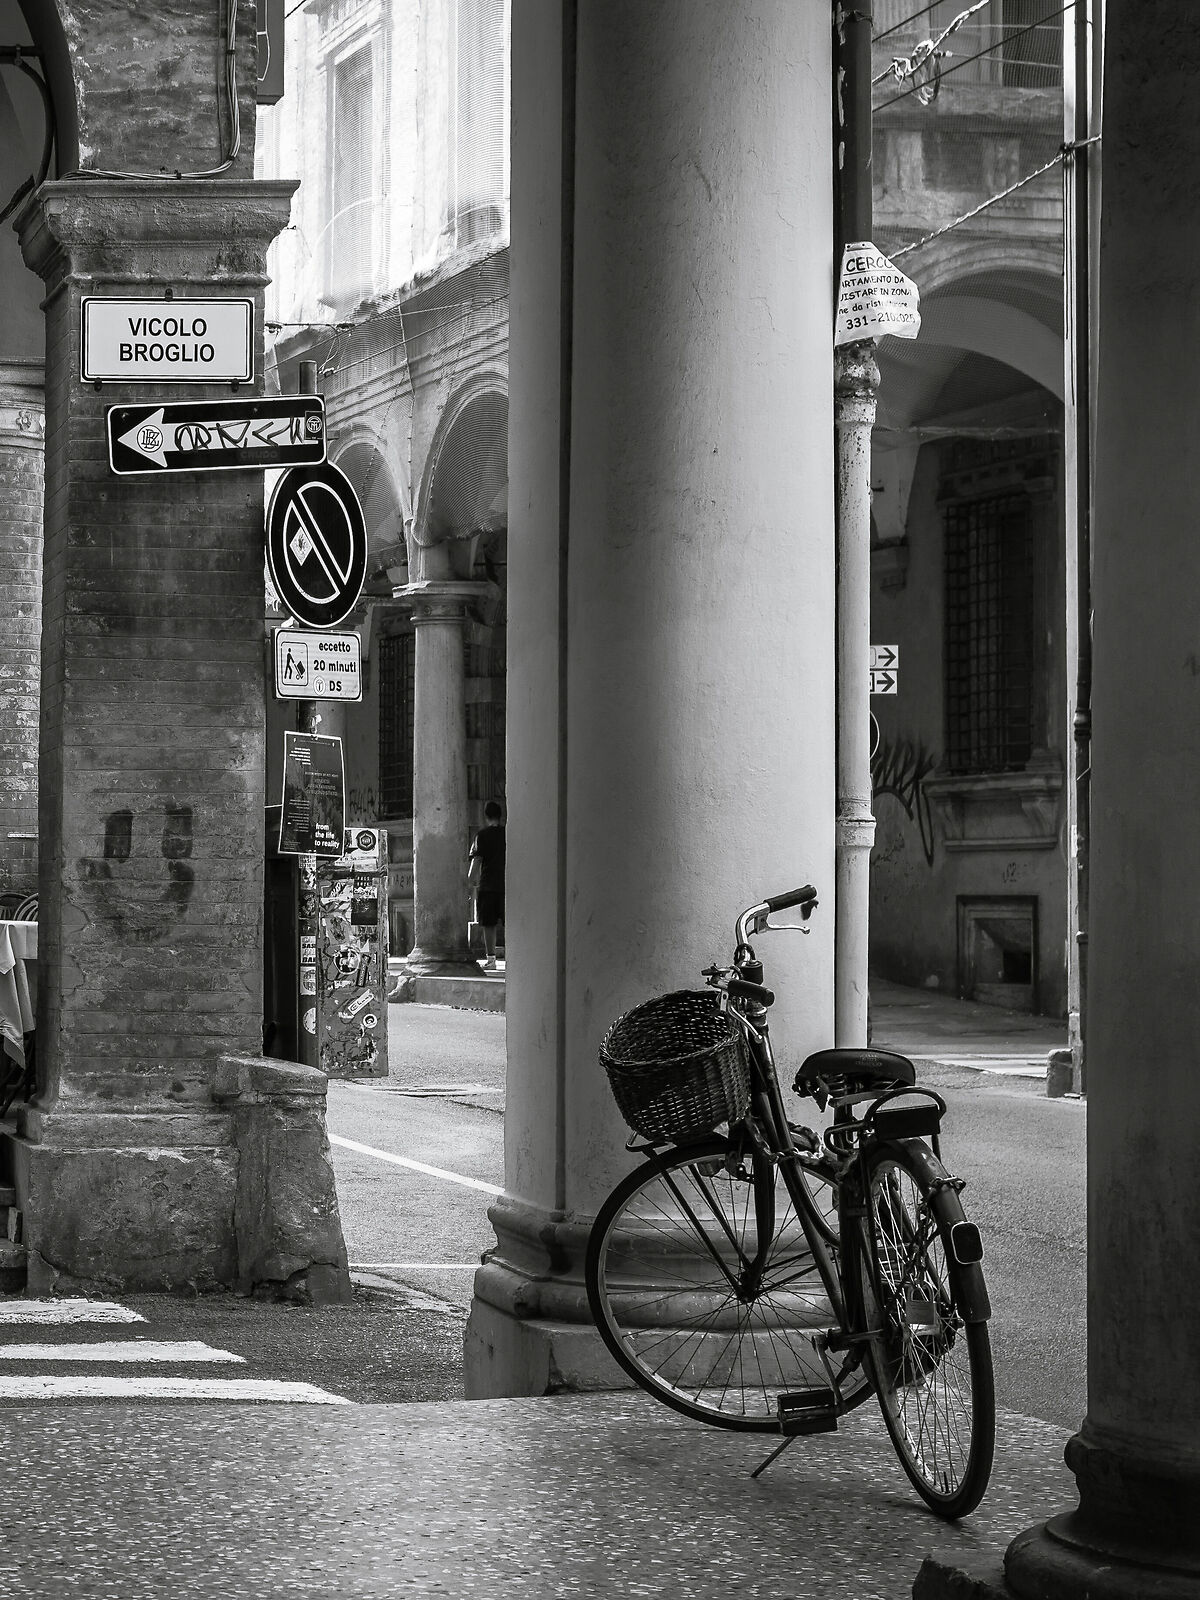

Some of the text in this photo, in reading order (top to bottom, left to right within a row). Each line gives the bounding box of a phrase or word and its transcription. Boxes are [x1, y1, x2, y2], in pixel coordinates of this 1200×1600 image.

[894, 276, 905, 284] DA
[880, 288, 889, 296] IN
[852, 302, 863, 312] da
[128, 317, 208, 337] VICOLO
[119, 343, 215, 363] BROGLIO
[318, 641, 351, 653] eccetto
[313, 660, 357, 673] 20 minuti
[329, 680, 342, 692] DS
[315, 822, 330, 831] from
[325, 831, 335, 839] life
[321, 840, 340, 849] reality
